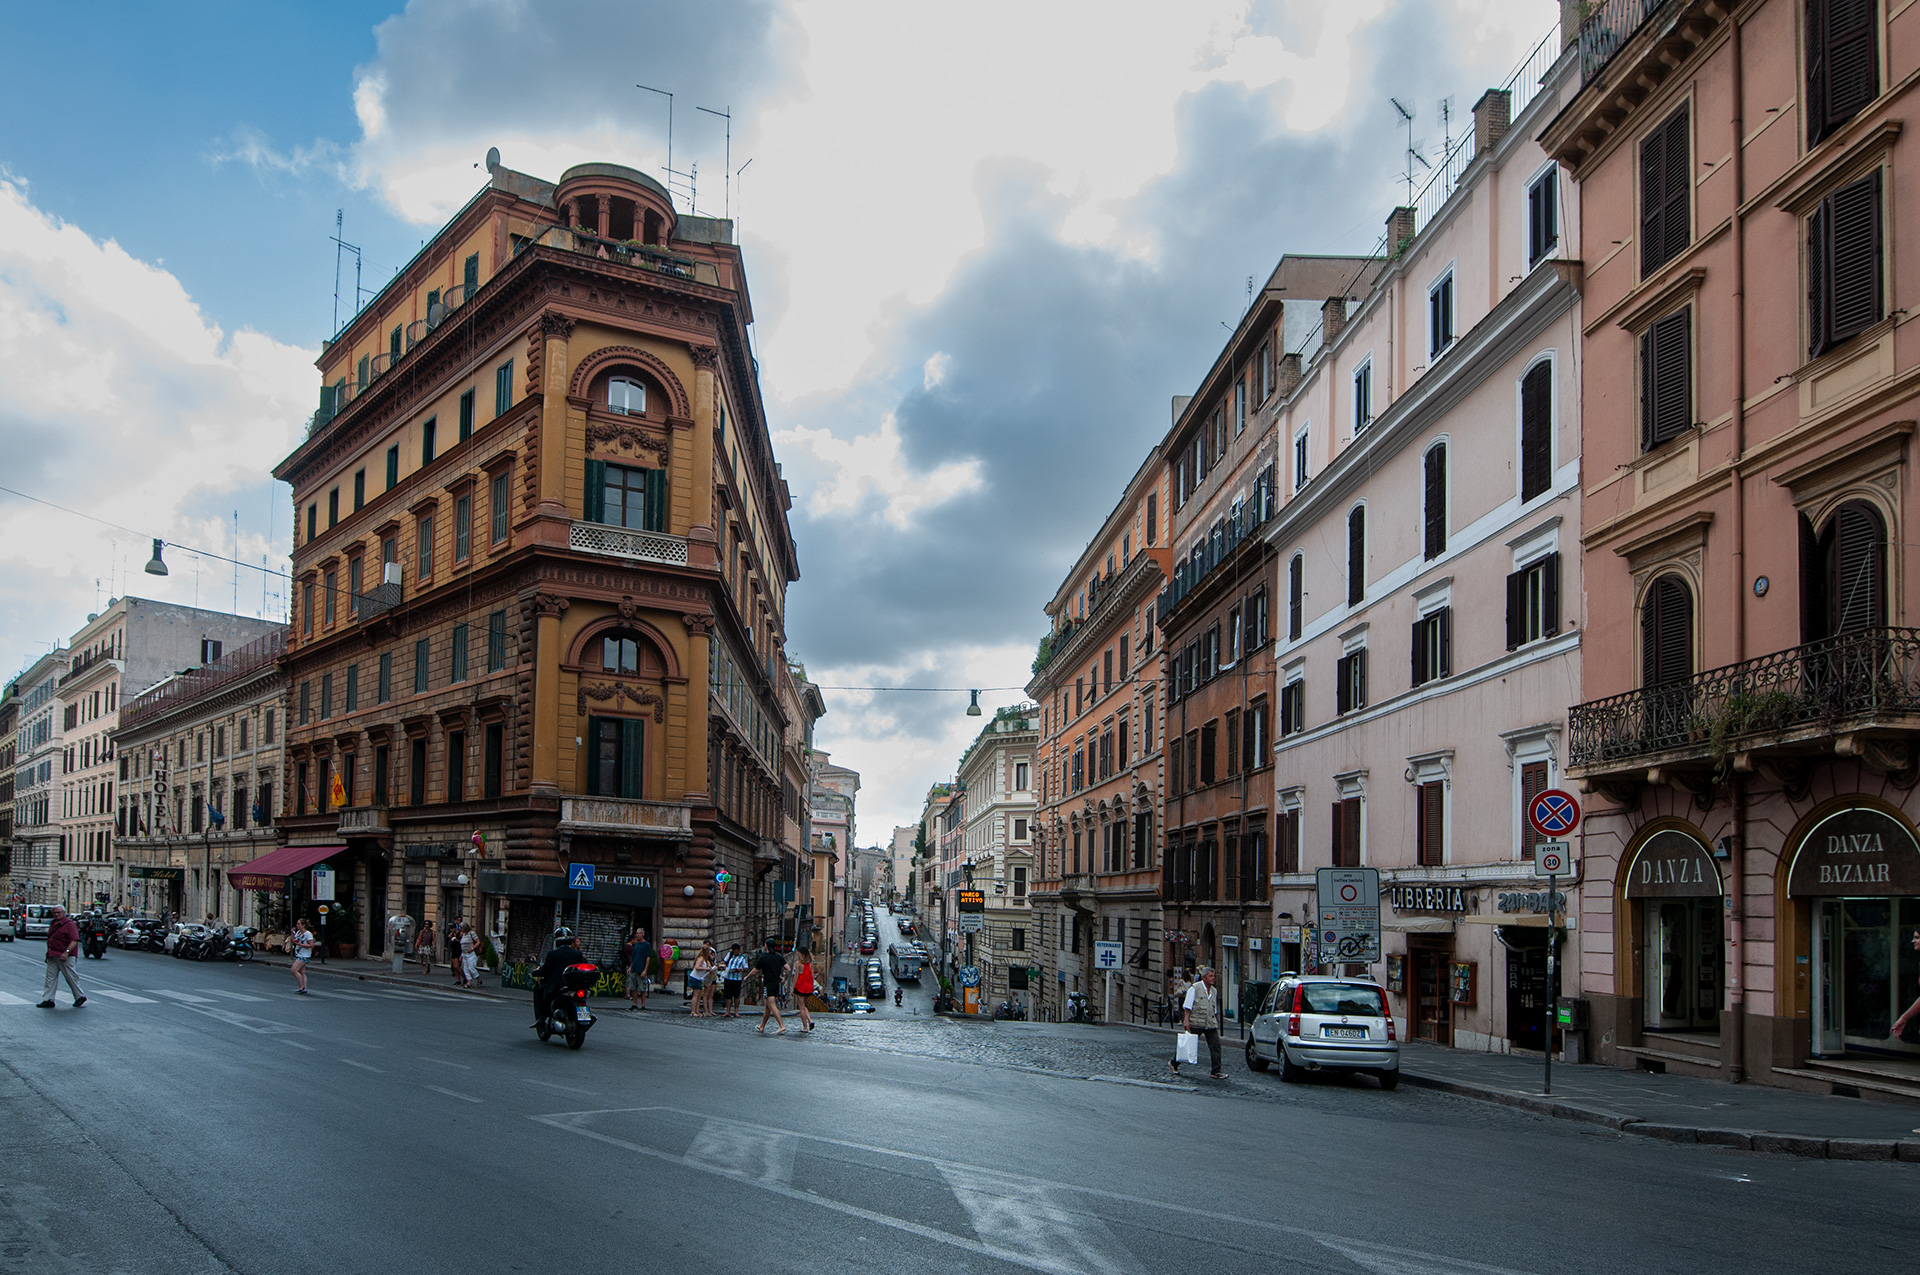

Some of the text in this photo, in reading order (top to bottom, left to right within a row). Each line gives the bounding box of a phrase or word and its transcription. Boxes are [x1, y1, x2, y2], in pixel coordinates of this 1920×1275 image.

[154, 770, 167, 829] HOTEL
[1827, 833, 1884, 854] DANZA
[1547, 858, 1557, 866] 30
[1641, 858, 1703, 884] DANZA
[150, 869, 178, 879] Hotel
[1819, 863, 1891, 883] BAZAAR
[1392, 887, 1465, 911] LIBRERIA
[1528, 891, 1567, 912] BAR
[1509, 964, 1518, 989] BAR
